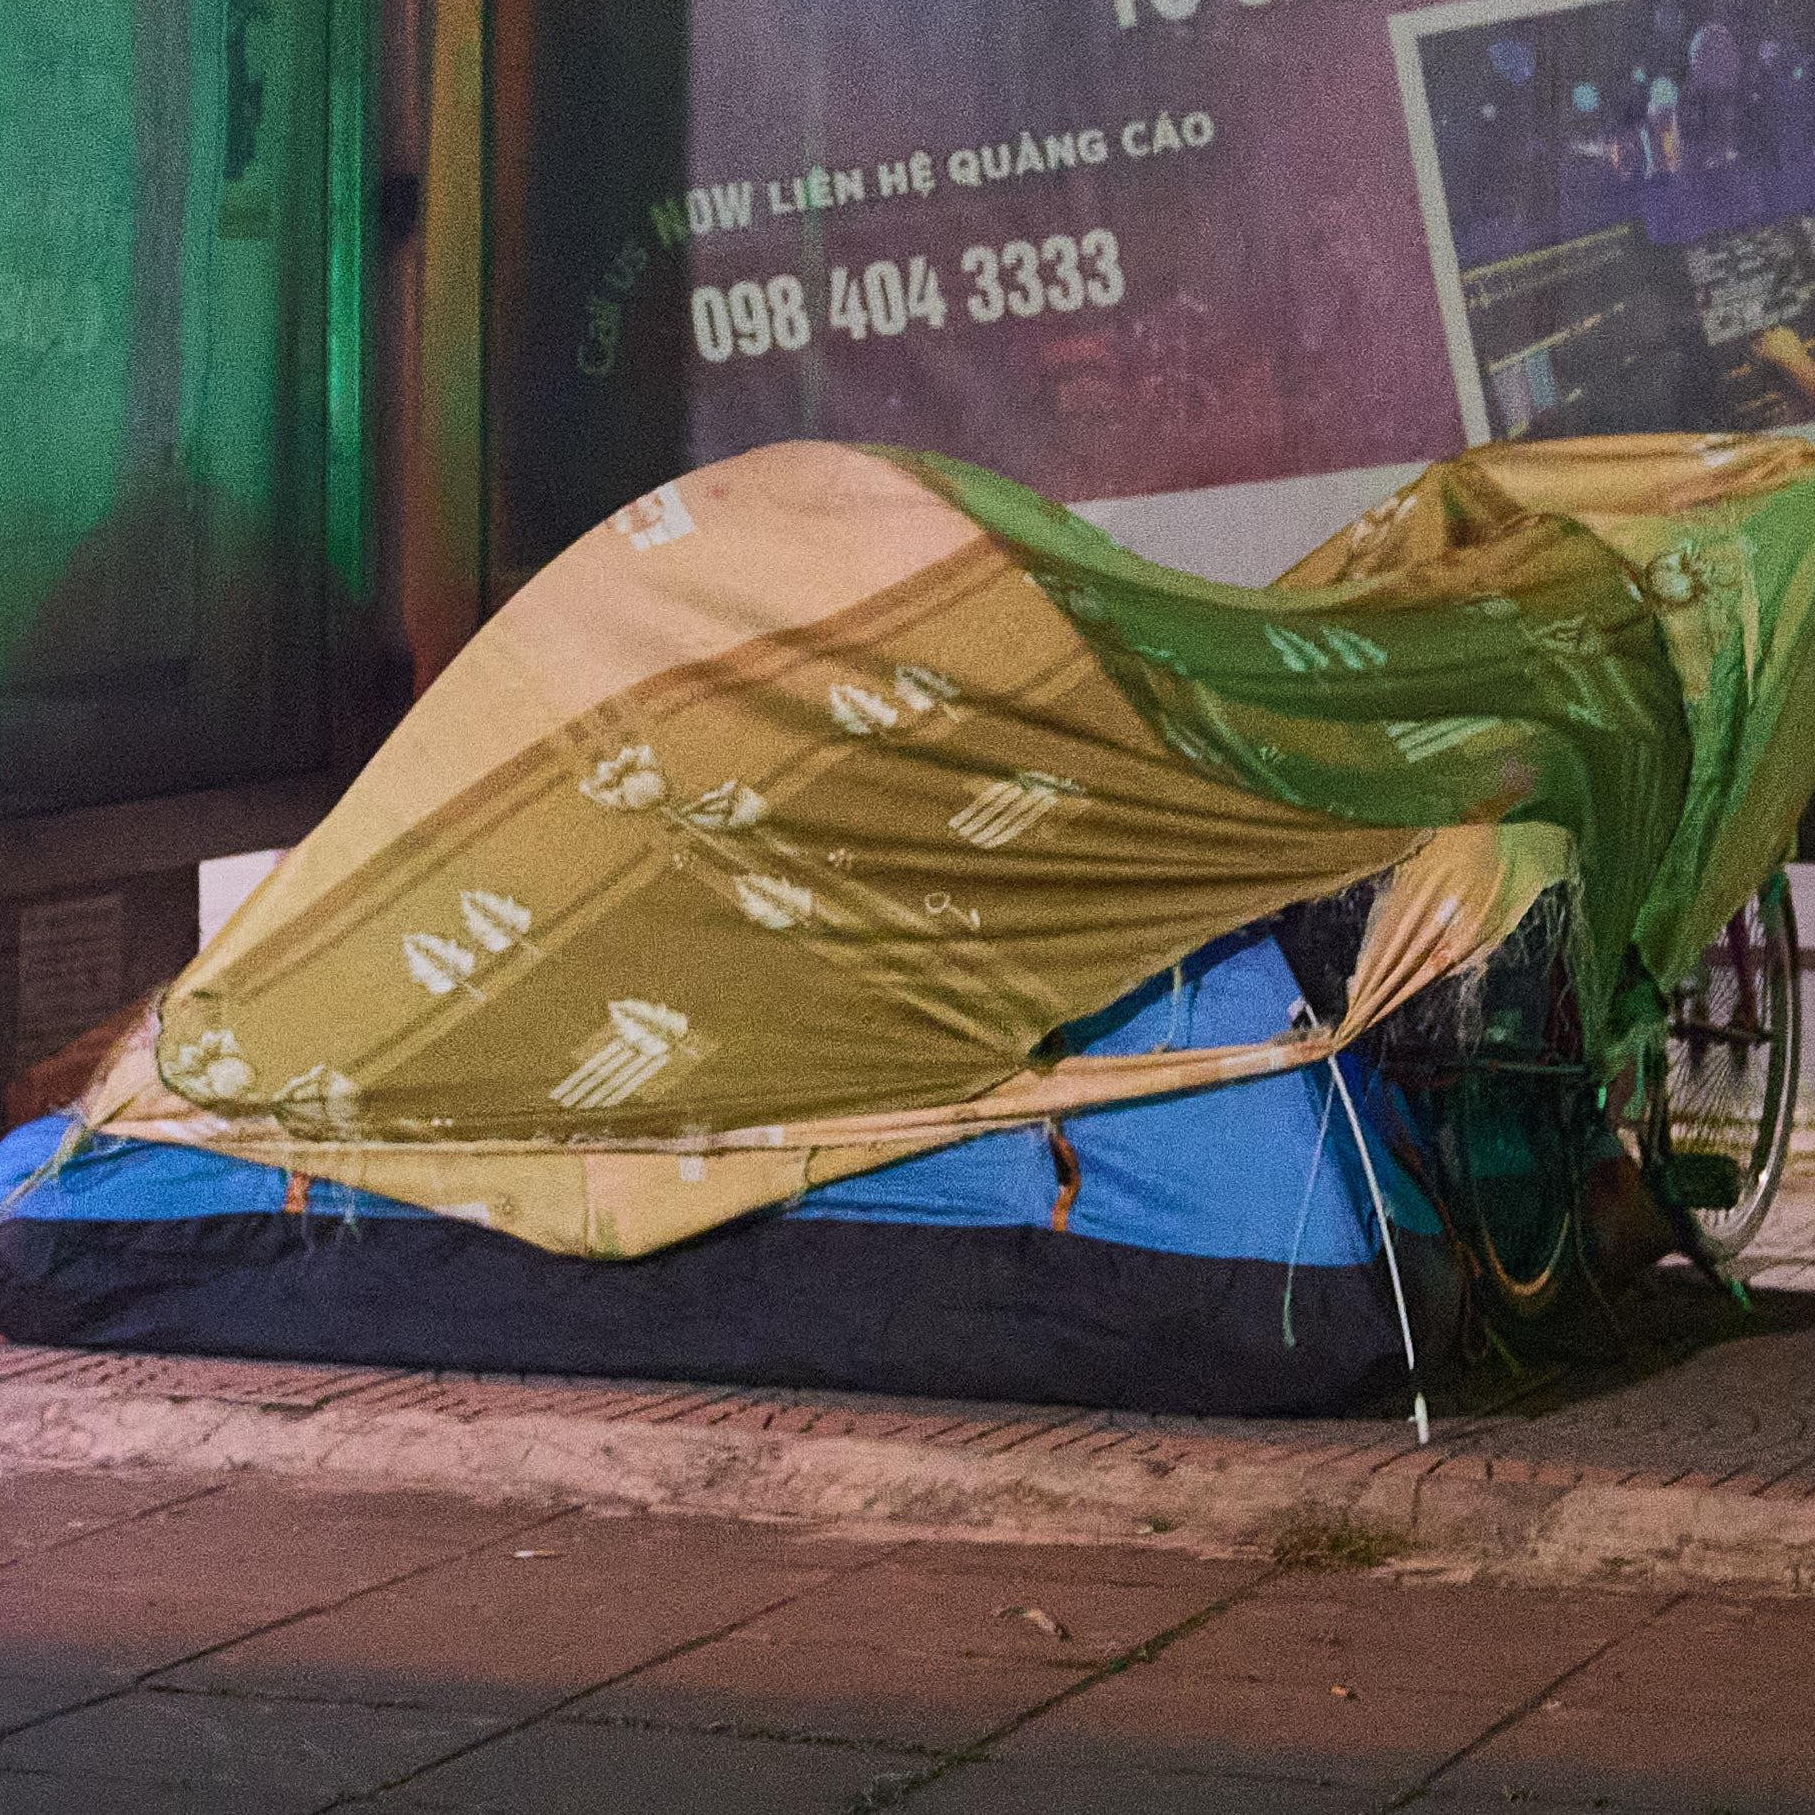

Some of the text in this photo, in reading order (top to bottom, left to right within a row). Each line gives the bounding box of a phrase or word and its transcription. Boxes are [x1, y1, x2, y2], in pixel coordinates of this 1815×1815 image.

[648, 178, 754, 251] NOW
[768, 164, 866, 217] LIÊN
[877, 150, 935, 202] HỆ
[947, 123, 1109, 189] QUẢNG
[690, 227, 1125, 364] 098 404 3333
